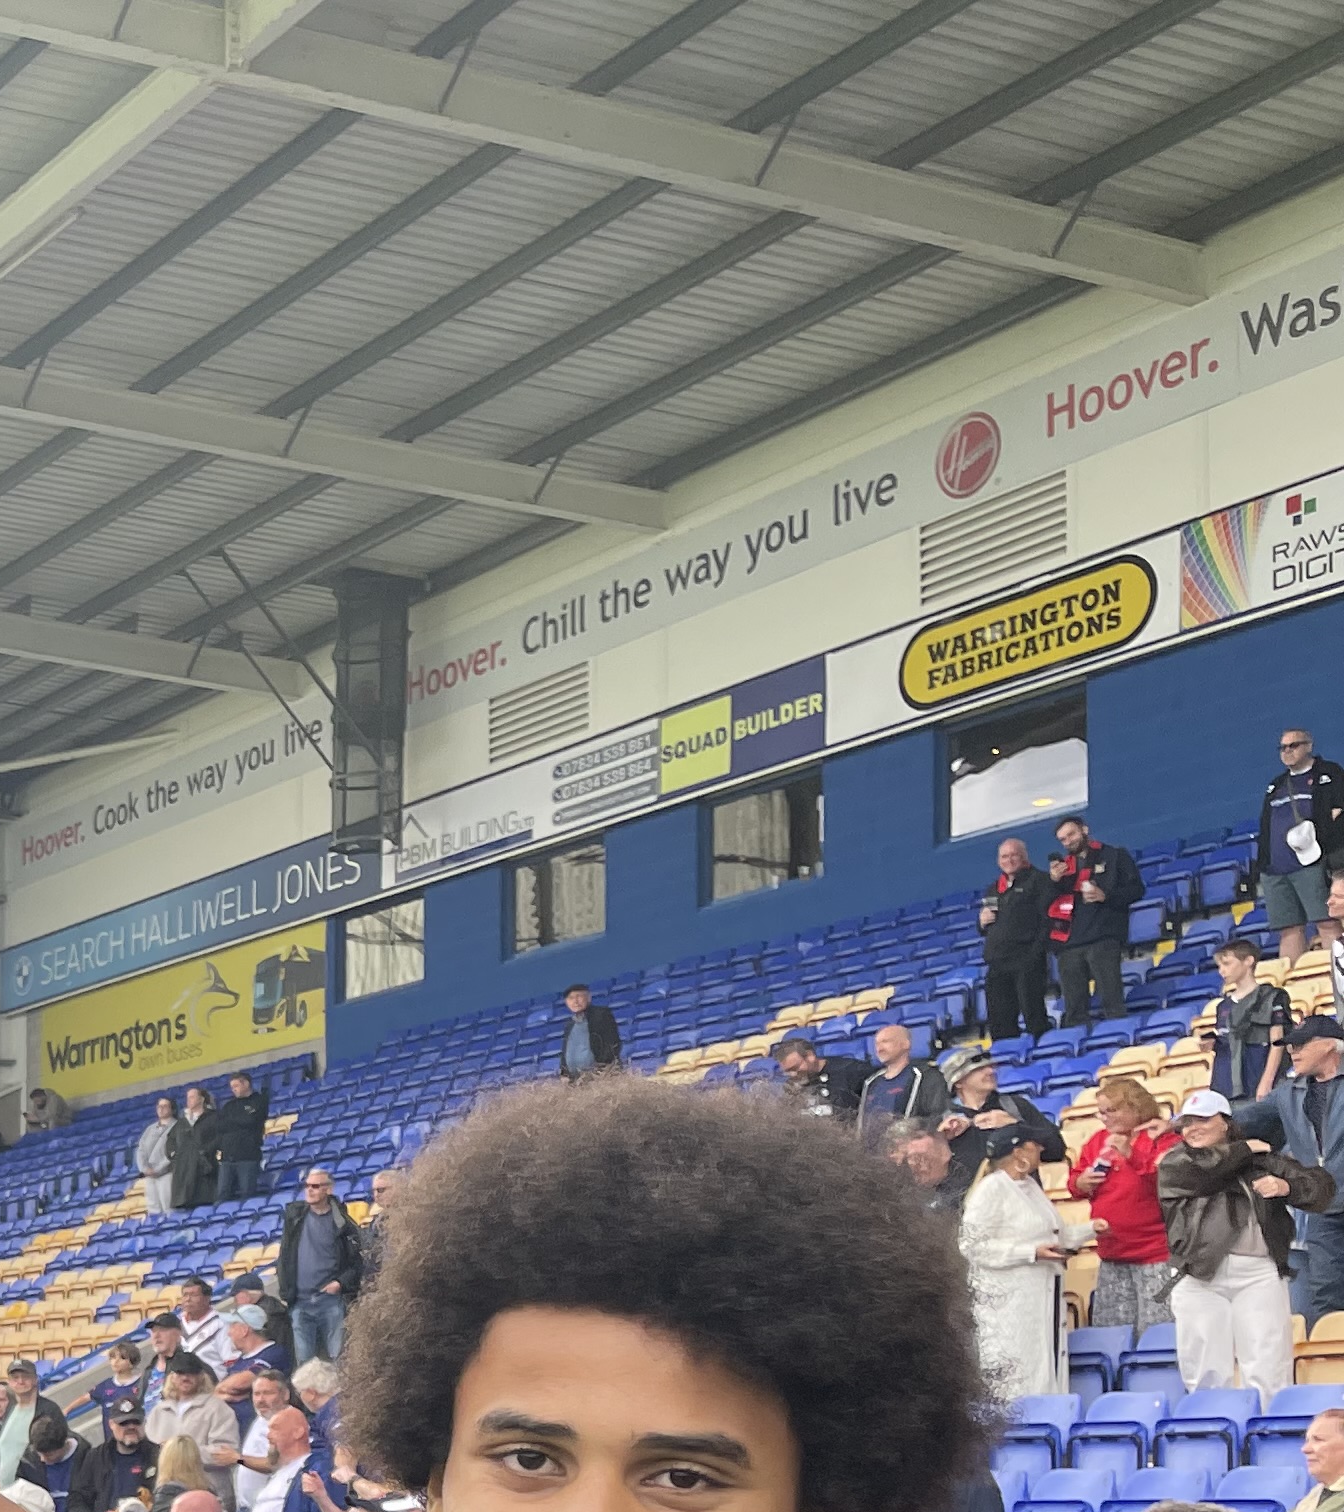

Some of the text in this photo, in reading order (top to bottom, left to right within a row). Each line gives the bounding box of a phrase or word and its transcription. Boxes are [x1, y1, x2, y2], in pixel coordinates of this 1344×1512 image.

[1046, 284, 1343, 438] Hoover. Was
[408, 472, 899, 700] Hoover. Chill the way you live
[927, 578, 1123, 665] WARRINGTON
[927, 607, 1122, 690] FABRICATIONS
[661, 691, 824, 765] SQUAD BUILDER
[21, 719, 323, 866] Hoover. Cook the way you live
[441, 811, 520, 856] BUILDING
[40, 851, 363, 986] SEARCH HALLIWELL JONES
[166, 1042, 203, 1065] buses
